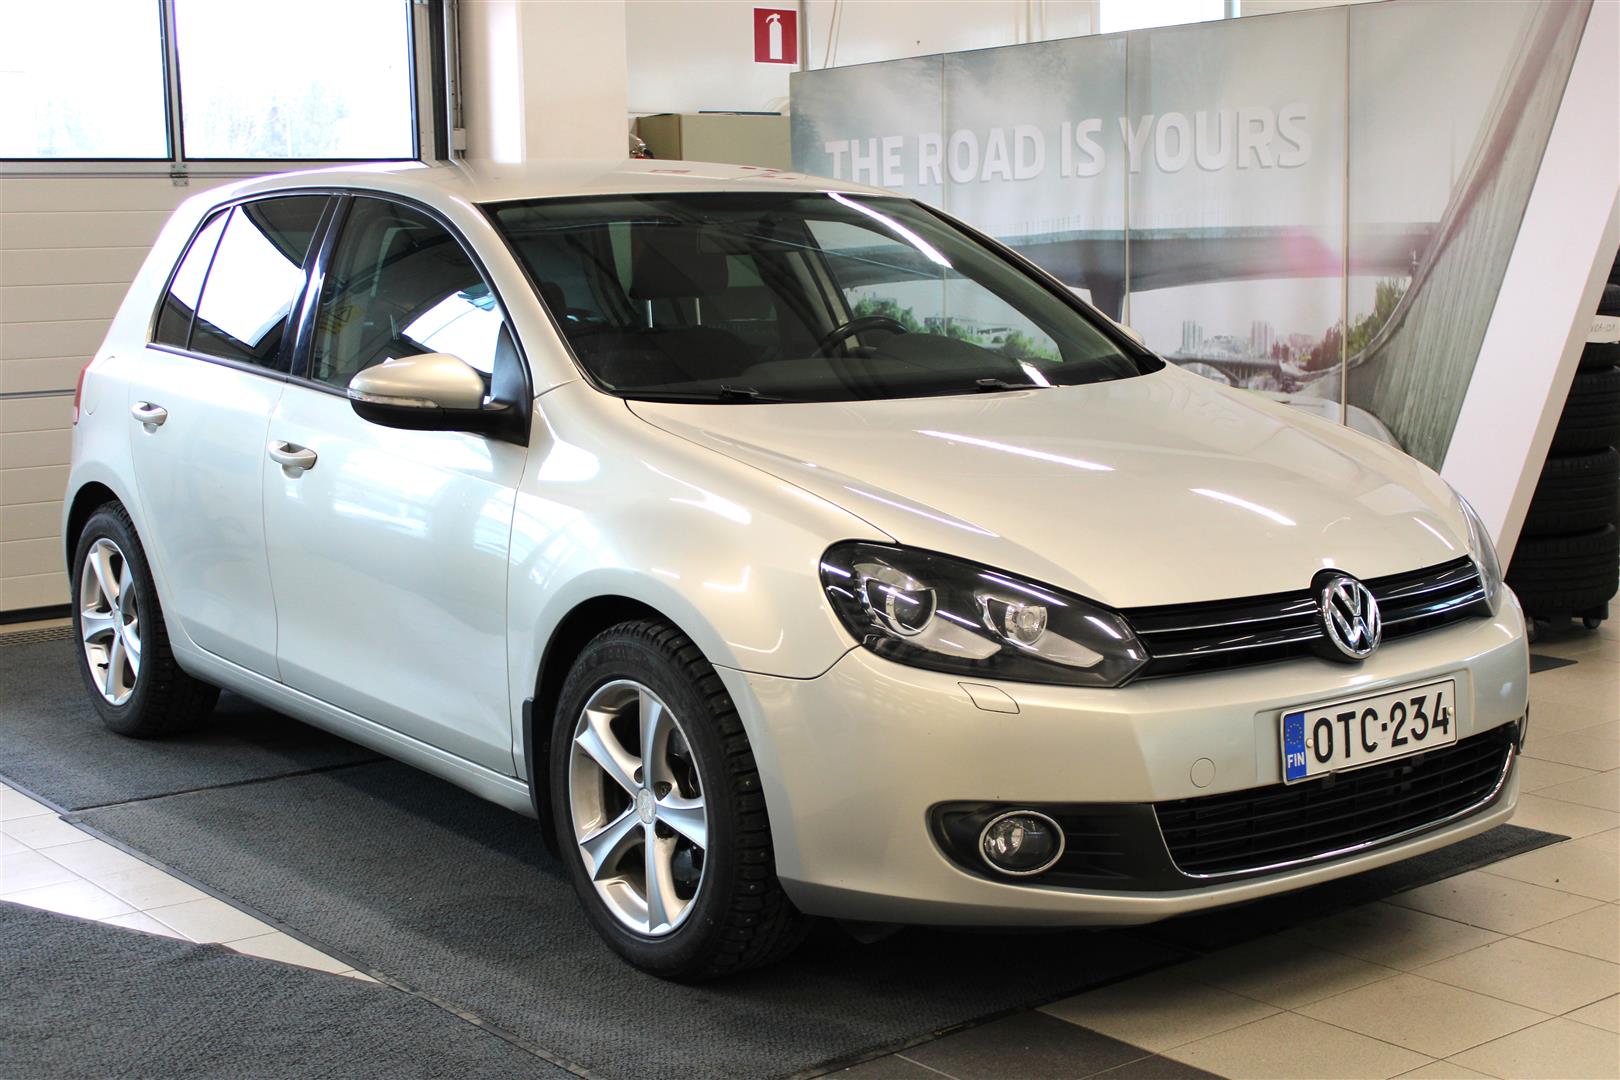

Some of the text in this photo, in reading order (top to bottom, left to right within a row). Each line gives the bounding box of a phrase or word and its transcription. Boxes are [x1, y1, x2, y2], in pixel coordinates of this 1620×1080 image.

[825, 102, 1313, 188] THE ROAD IS YOURS
[1287, 751, 1305, 769] FIN
[1313, 691, 1449, 763] OTC-234
